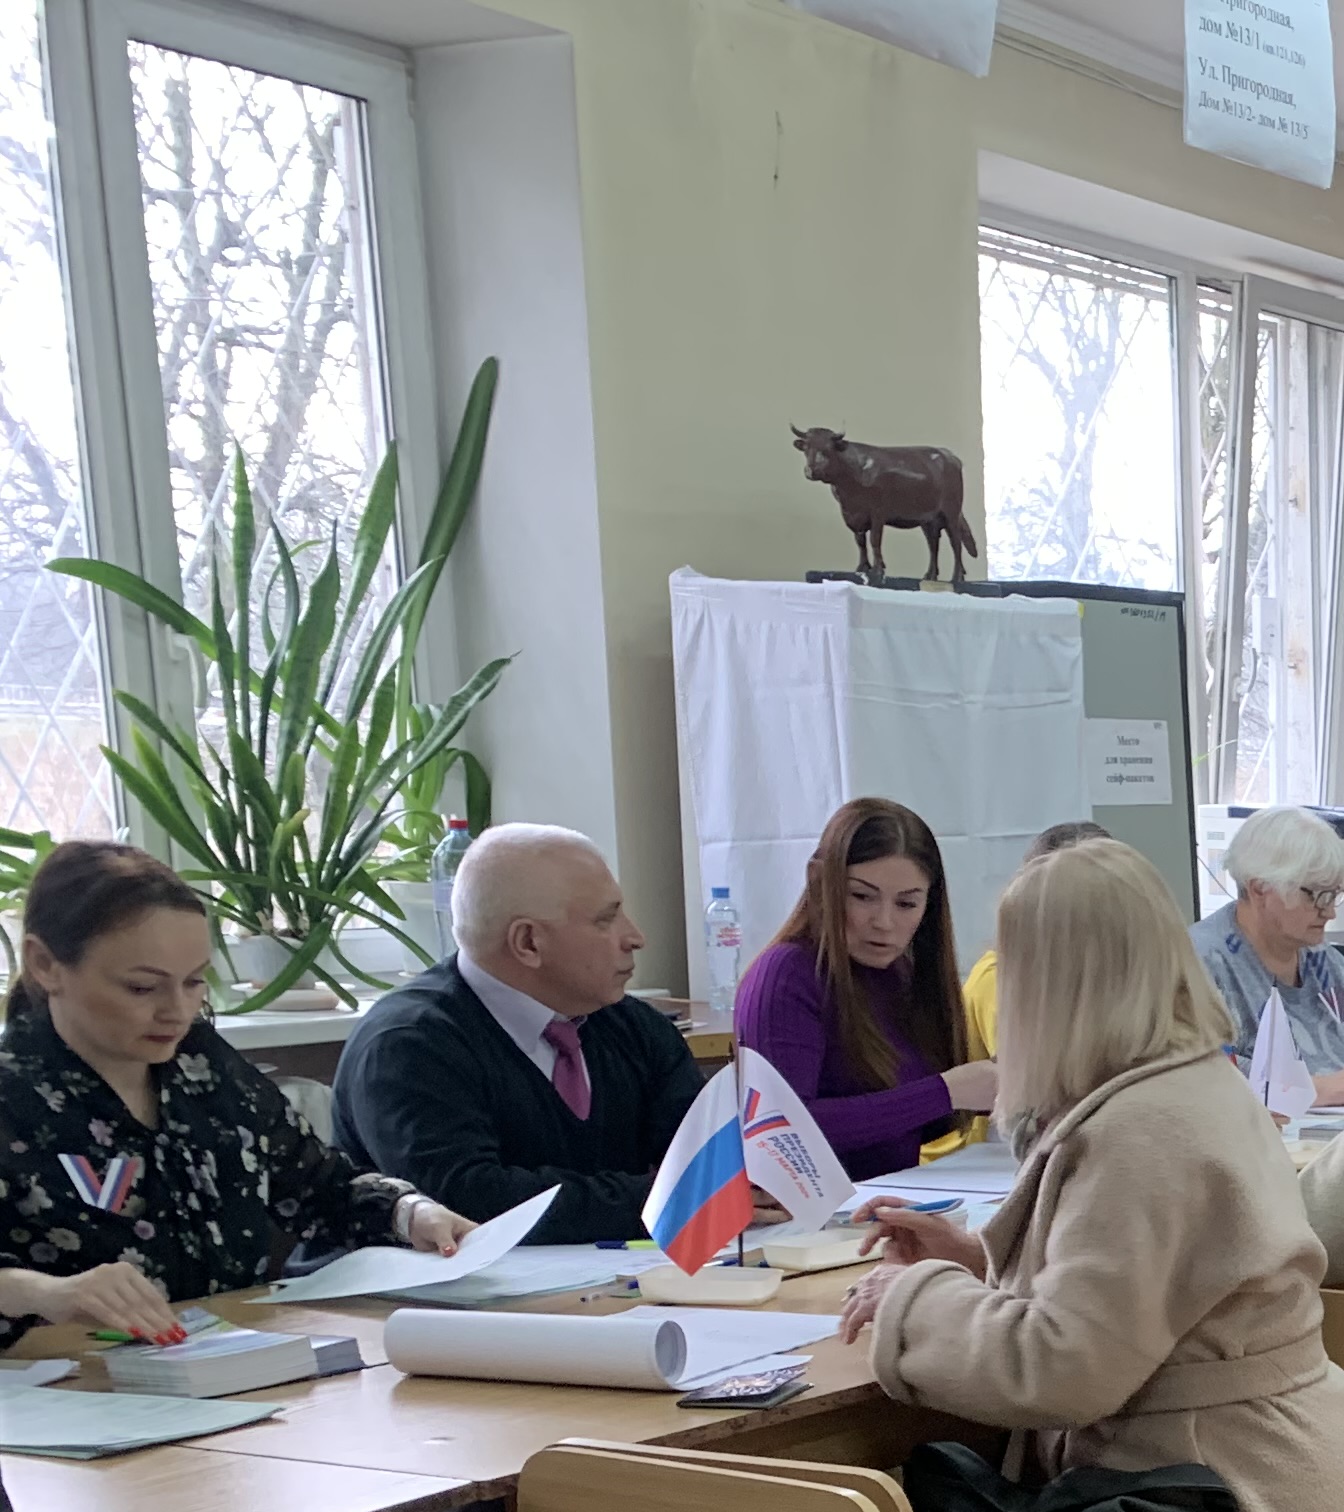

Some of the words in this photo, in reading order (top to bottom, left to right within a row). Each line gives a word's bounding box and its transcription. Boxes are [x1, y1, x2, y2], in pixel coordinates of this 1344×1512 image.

[1199, 16, 1222, 36] дом
[1220, 0, 1295, 31] ригородная,
[1198, 57, 1219, 81] Ул.
[1221, 64, 1297, 109] Пригородная,
[1198, 90, 1220, 111] Дом
[1257, 114, 1276, 129] дом
[1277, 117, 1288, 134] №
[767, 1136, 804, 1174] РОССИИ
[780, 1133, 824, 1198] ПРЕЗИДЕНТА
[790, 1132, 821, 1179] ВЫБОРЫ
